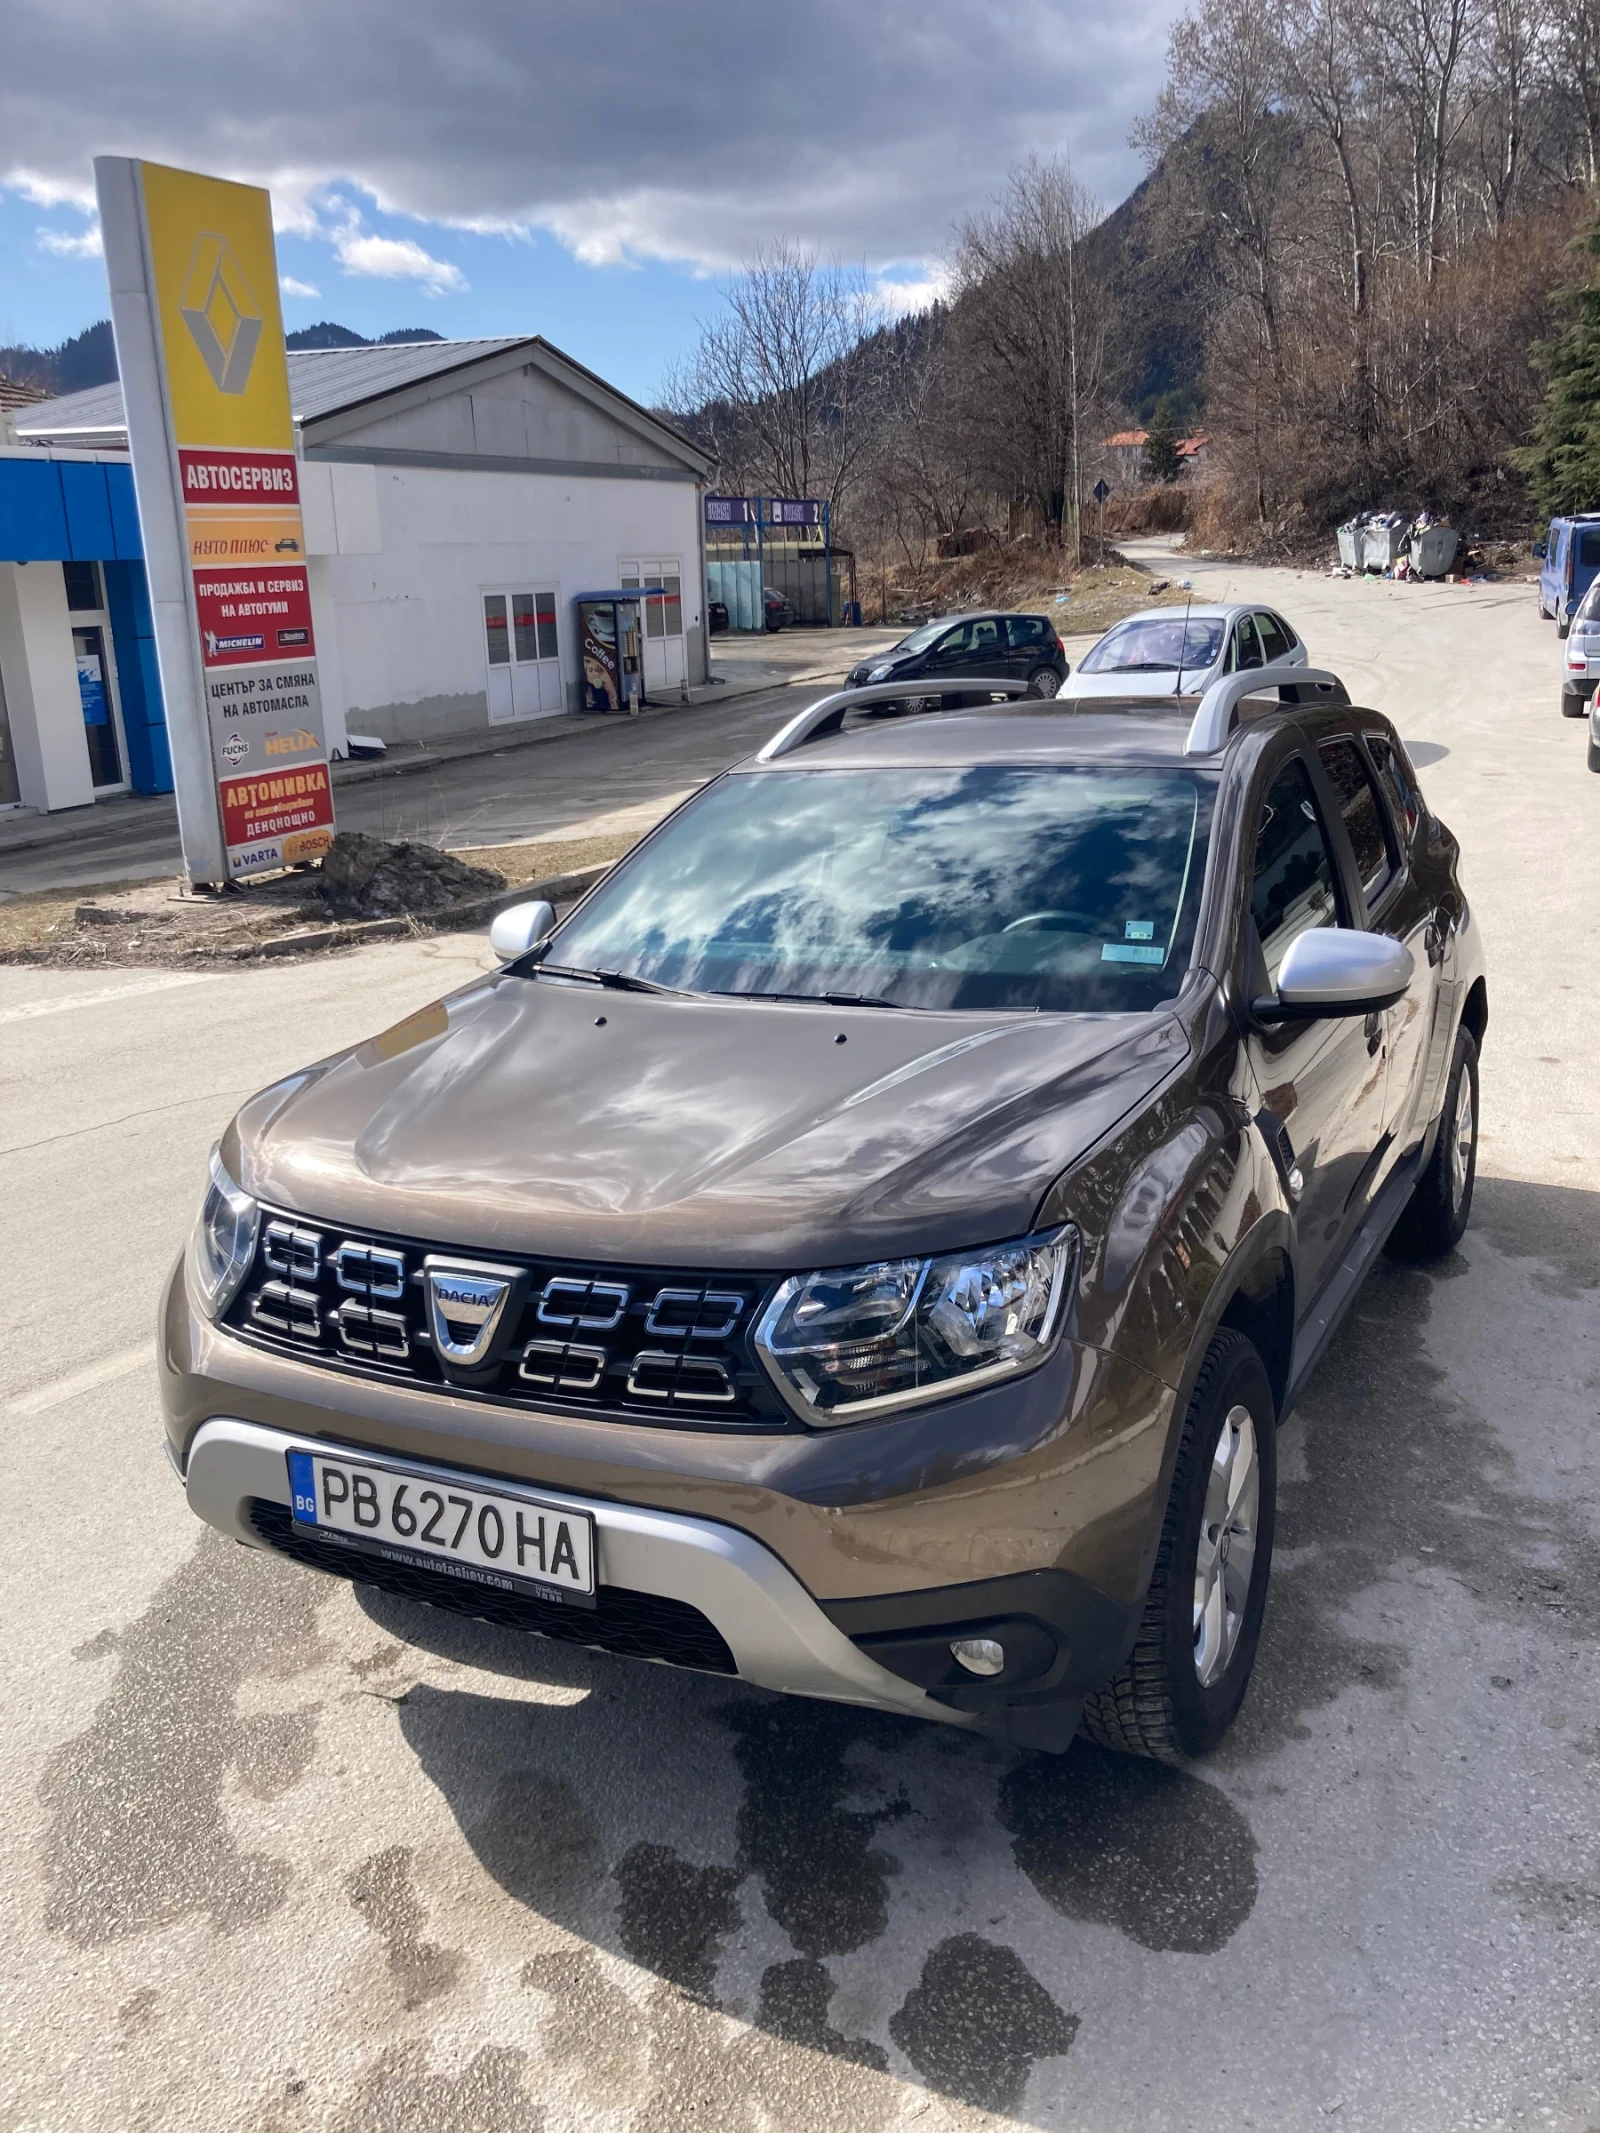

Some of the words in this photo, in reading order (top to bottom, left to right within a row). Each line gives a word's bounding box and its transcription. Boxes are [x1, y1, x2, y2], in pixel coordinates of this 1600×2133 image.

[187, 465, 294, 491] АВТОСЕРВИЗ
[742, 501, 748, 522] 1
[813, 503, 819, 523] 2
[199, 582, 255, 597] ПРОДАЖБА
[258, 581, 265, 594] И
[267, 580, 304, 593] СЕРВИЗ
[221, 605, 236, 617] НА
[238, 602, 289, 616] АВТОГУМИ
[219, 638, 262, 649] MICHELIN
[584, 638, 615, 670] Coffee
[211, 680, 256, 699] ЦЕНТЪР
[258, 679, 273, 692] ЗА
[276, 673, 315, 690] СМЯНА
[223, 705, 239, 719] НА
[242, 695, 309, 716] АВТОМАСЛА
[222, 743, 248, 755] FUCHS
[264, 731, 320, 756] HELIX
[226, 772, 326, 807] АВТОМИВКА
[247, 811, 315, 837] ДЕНОНОЩНО
[299, 835, 330, 850] BOSCH
[242, 848, 278, 865] VARTA
[438, 1288, 490, 1307] DACIA
[296, 1494, 314, 1513] BG
[322, 1467, 381, 1528] PB
[391, 1484, 505, 1559] 6270
[516, 1511, 580, 1580] HA
[380, 1548, 513, 1591] www.autotashev.com
